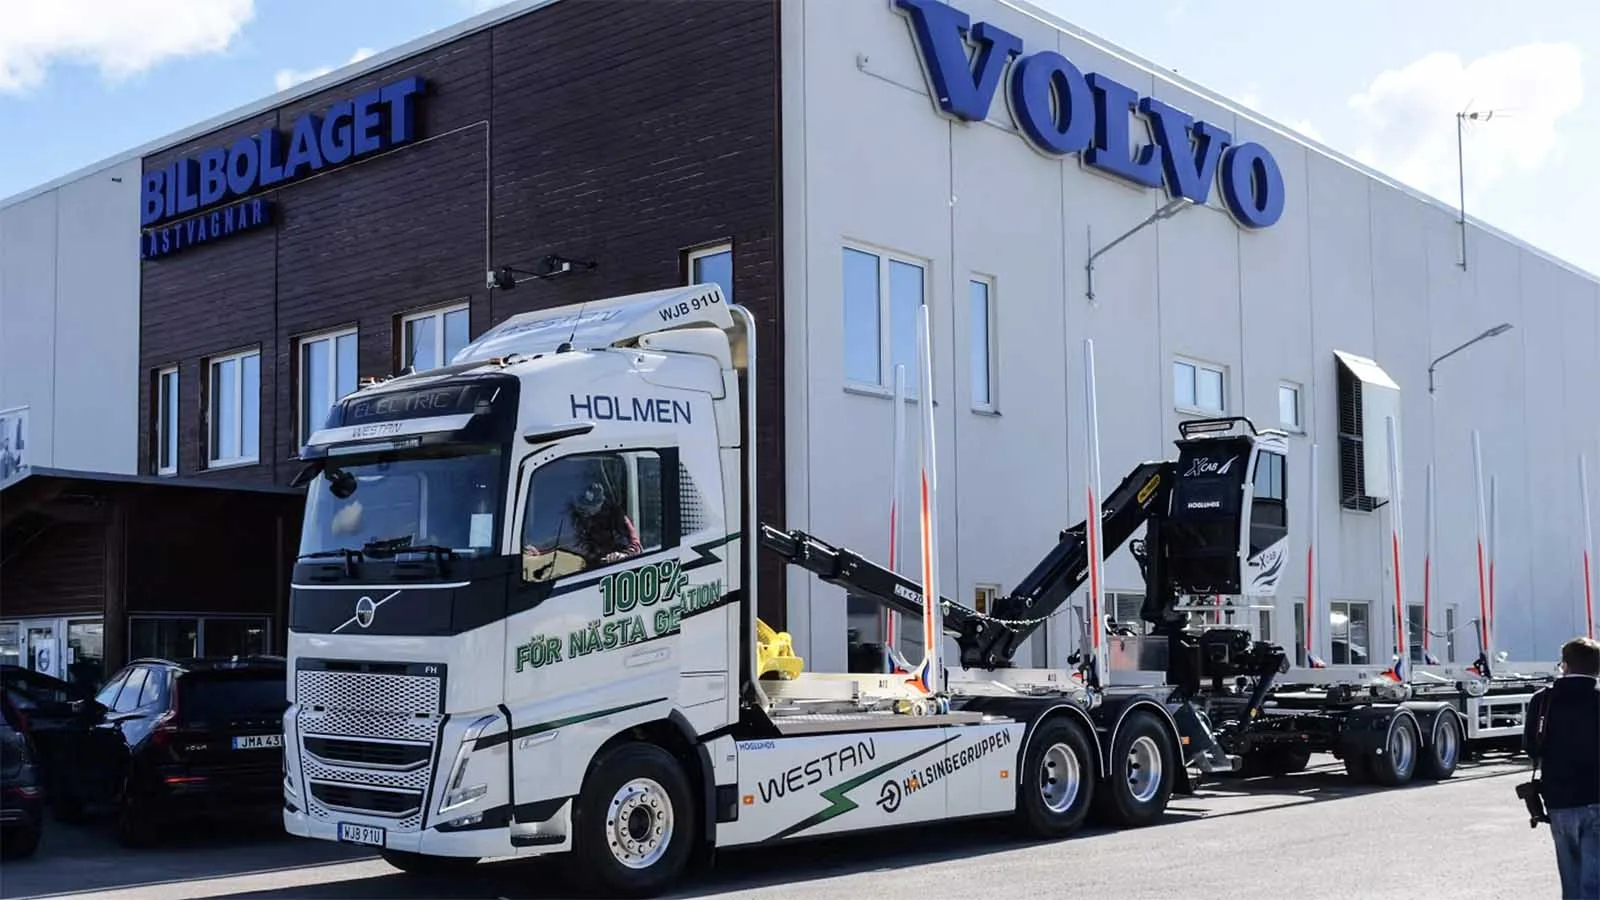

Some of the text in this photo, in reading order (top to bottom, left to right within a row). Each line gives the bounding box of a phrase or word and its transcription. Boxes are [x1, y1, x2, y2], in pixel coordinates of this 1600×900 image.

[892, 0, 1286, 230] VOLVO
[141, 77, 427, 226] BILBOLAGET
[141, 199, 262, 258] ASTVAGNAR
[659, 289, 721, 322] WJB 91U
[352, 424, 402, 437] WESTAN
[570, 395, 692, 424] HOLMEN
[600, 560, 688, 617] 100%
[425, 666, 437, 674] FH
[515, 634, 563, 673] FÖR
[568, 615, 648, 660] NÄSTA
[241, 734, 284, 748] JMA 43
[903, 728, 1011, 797] HÄLSINGEGRUPPEN
[758, 738, 876, 804] WESTAN
[344, 825, 380, 843] WJB 91U
